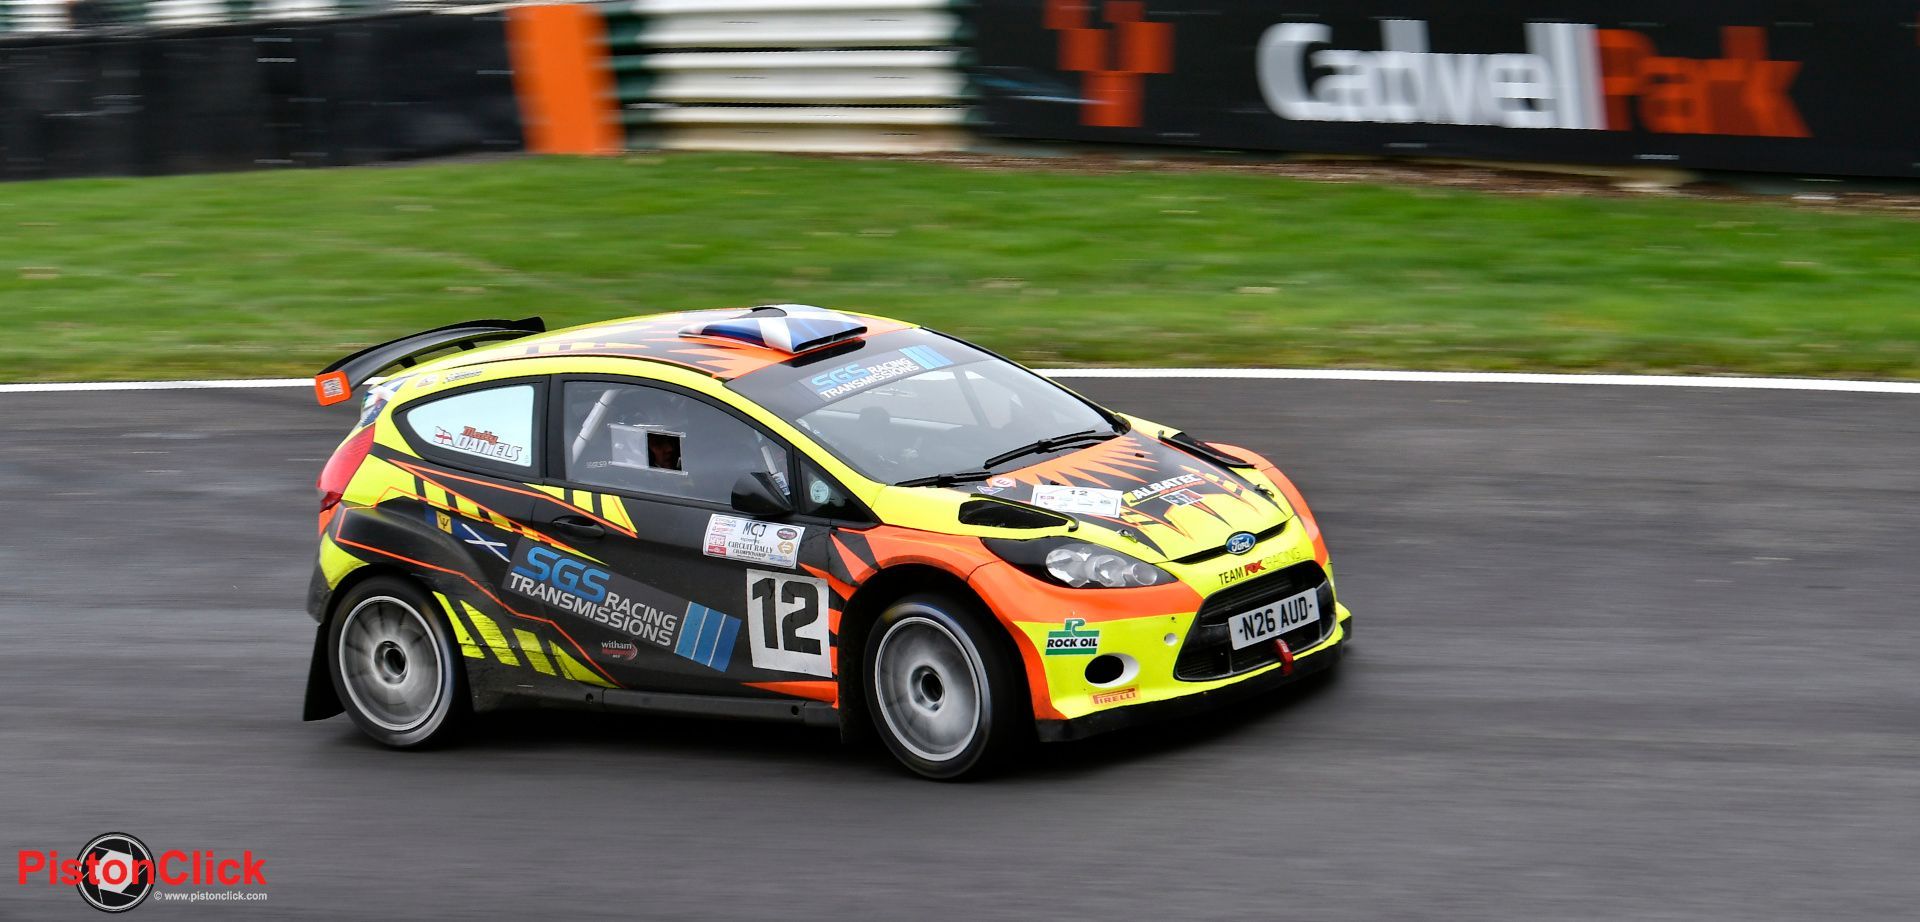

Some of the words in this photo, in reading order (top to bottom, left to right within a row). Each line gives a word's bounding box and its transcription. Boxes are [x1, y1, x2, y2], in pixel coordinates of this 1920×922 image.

[811, 362, 871, 392] SGS
[869, 357, 915, 374] RACING
[820, 364, 920, 399] TRANSMISSIONS
[1069, 489, 1089, 497] 12
[1131, 473, 1203, 500] ALBATEC
[1231, 536, 1251, 552] Ford
[512, 546, 610, 602] SGS
[1218, 566, 1244, 585] TEAM
[510, 572, 673, 647] TRANSMISSIONS
[605, 591, 678, 632] RACING
[752, 577, 822, 656] 12
[1242, 608, 1276, 641] N26
[1280, 596, 1309, 629] AUD
[601, 640, 632, 650] witham
[1047, 639, 1078, 648] ROCK
[1080, 638, 1098, 647] OIL
[1092, 687, 1136, 705] PIRELLI
